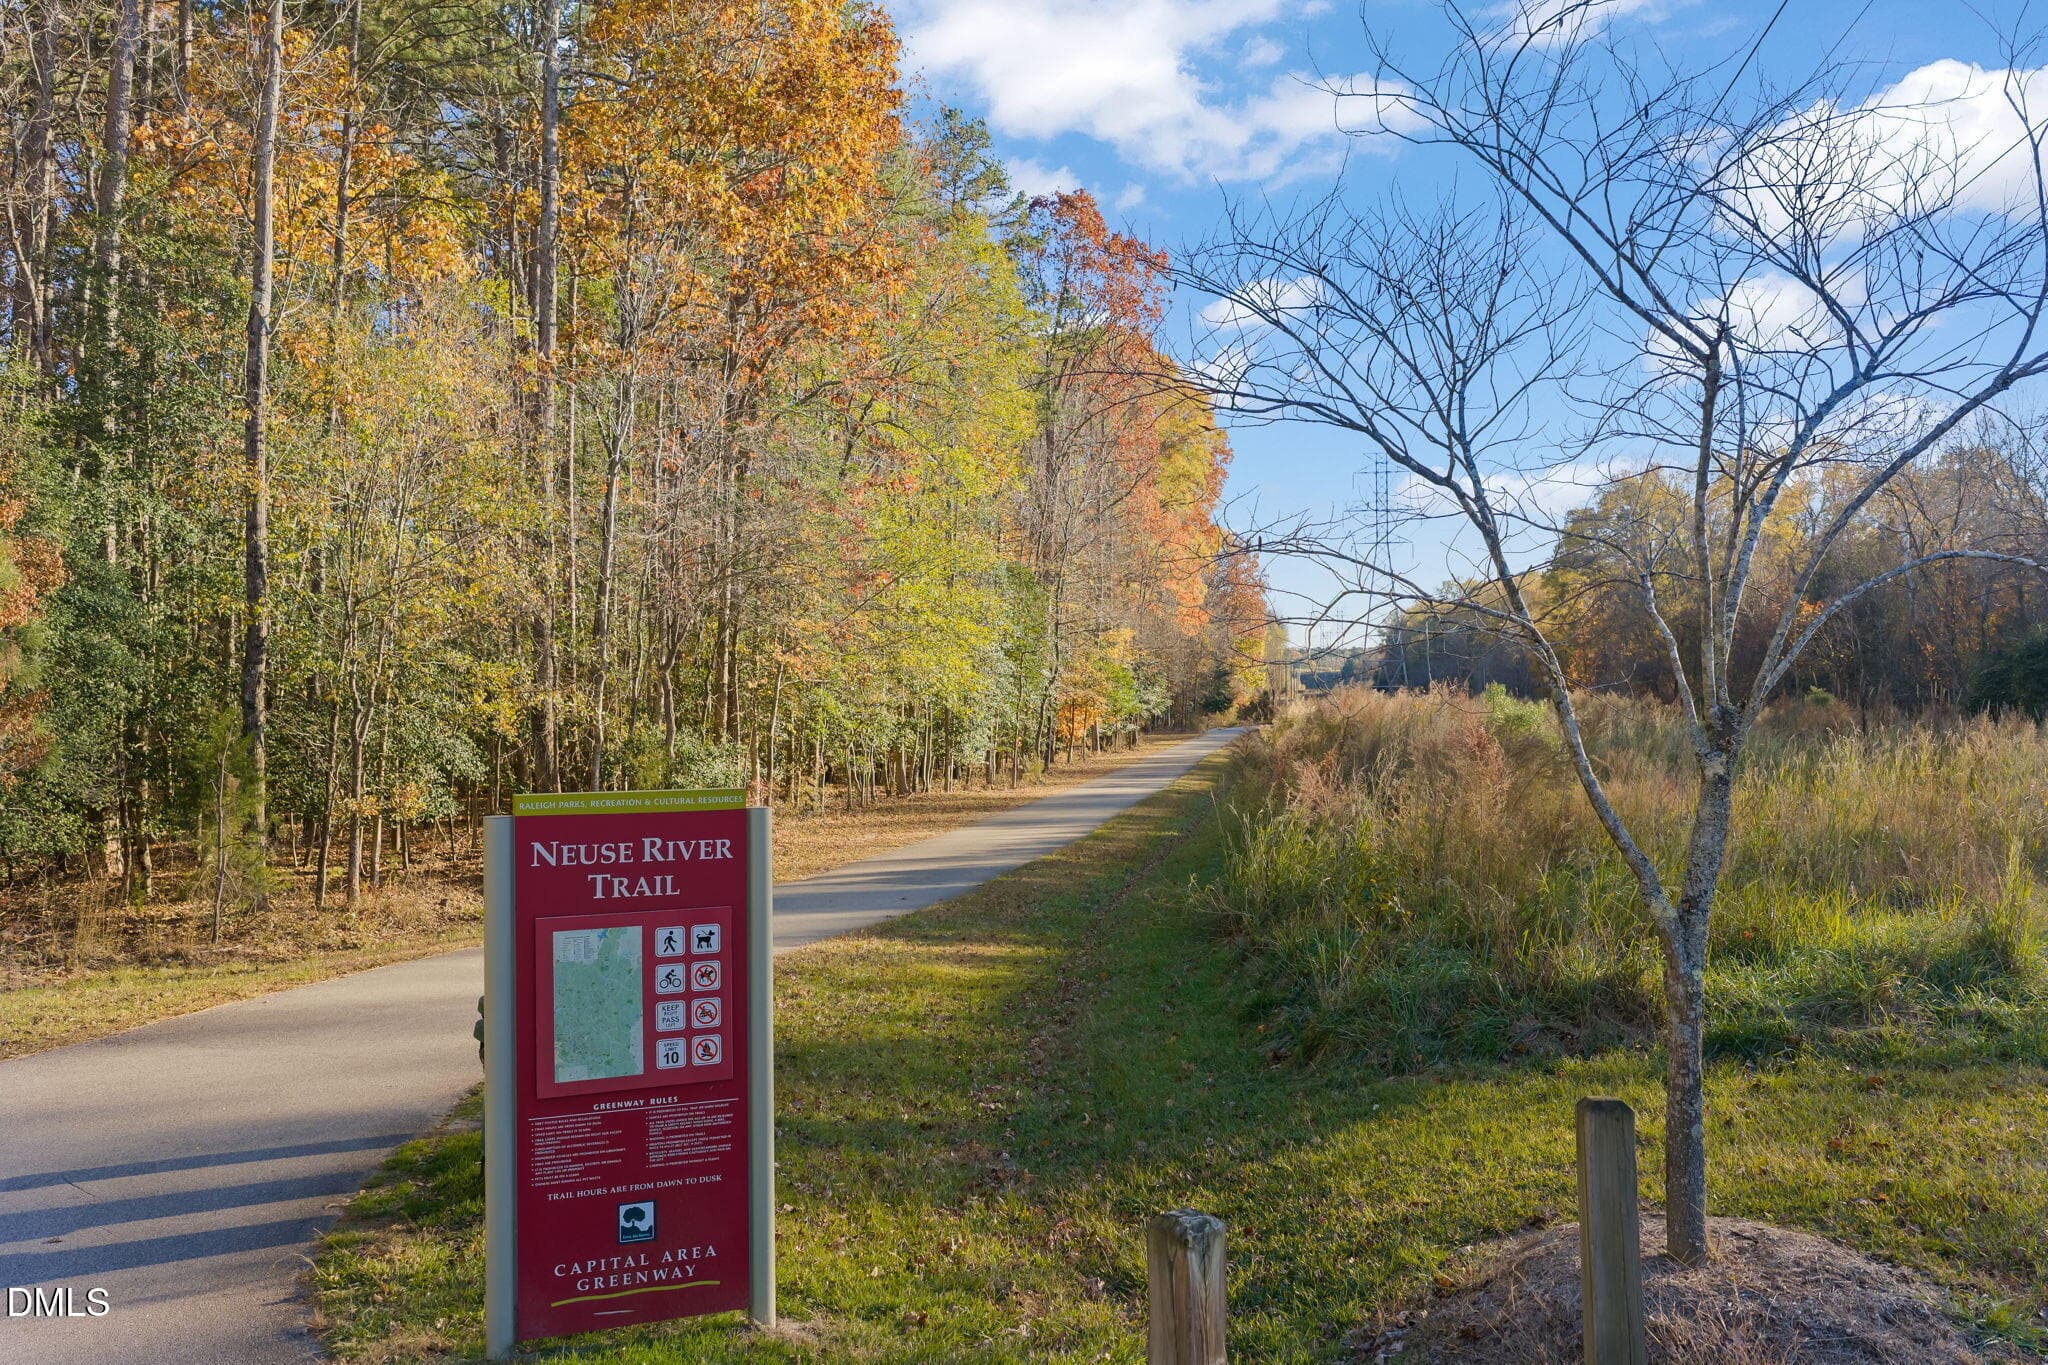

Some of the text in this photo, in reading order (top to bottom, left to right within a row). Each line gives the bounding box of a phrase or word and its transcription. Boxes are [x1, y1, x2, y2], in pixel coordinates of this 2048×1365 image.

[519, 801, 556, 810] RALEIGH
[590, 798, 642, 807] RECREATION
[644, 798, 651, 806] &
[653, 796, 695, 806] CULTURAL
[698, 795, 743, 804] RESOURCES
[530, 837, 733, 867] NEUSE RIVER
[587, 874, 681, 899] TRAIL
[663, 1052, 679, 1064] 10
[593, 1099, 645, 1111] GREENWAY
[650, 1096, 678, 1105] RULES
[547, 1174, 723, 1201] TRAIL HOURS ARE FROM DAWN TO DUSK
[554, 1245, 718, 1277] CAPITAL AREA
[576, 1264, 697, 1291] GREENWAY
